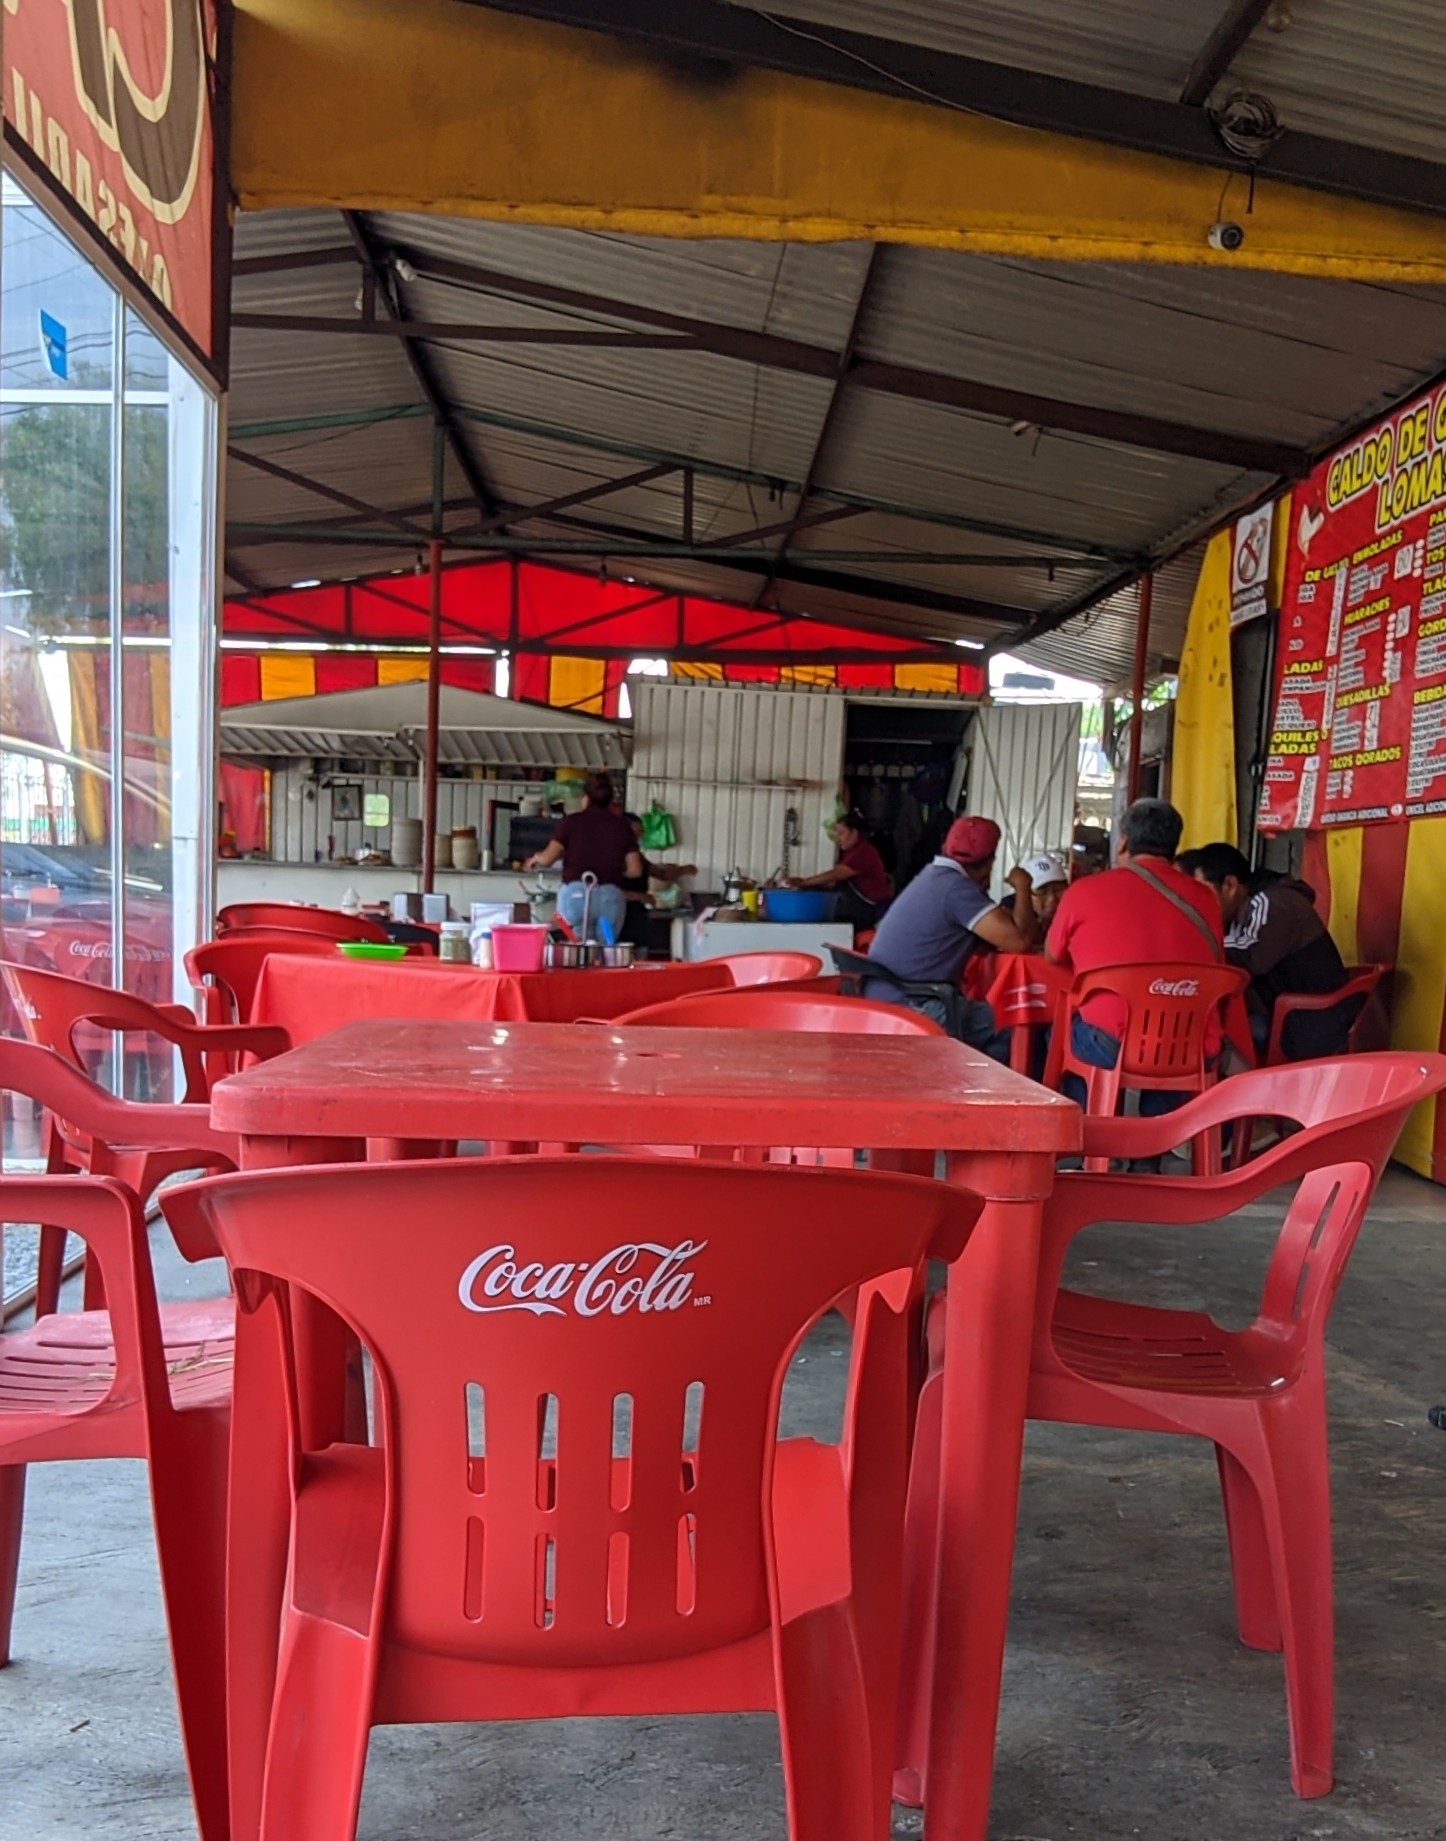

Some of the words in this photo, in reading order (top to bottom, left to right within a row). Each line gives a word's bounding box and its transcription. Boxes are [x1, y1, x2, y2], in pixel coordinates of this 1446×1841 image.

[1328, 426, 1393, 507] CALDO
[1397, 403, 1430, 467] DE
[1335, 684, 1391, 709] QUESADILLAS
[1269, 742, 1316, 755] LADAS
[1355, 746, 1402, 766] DORADOS
[1148, 978, 1199, 996] Coca-Cola
[458, 1239, 708, 1317] Coca-Cola
[693, 1295, 711, 1307] MR
